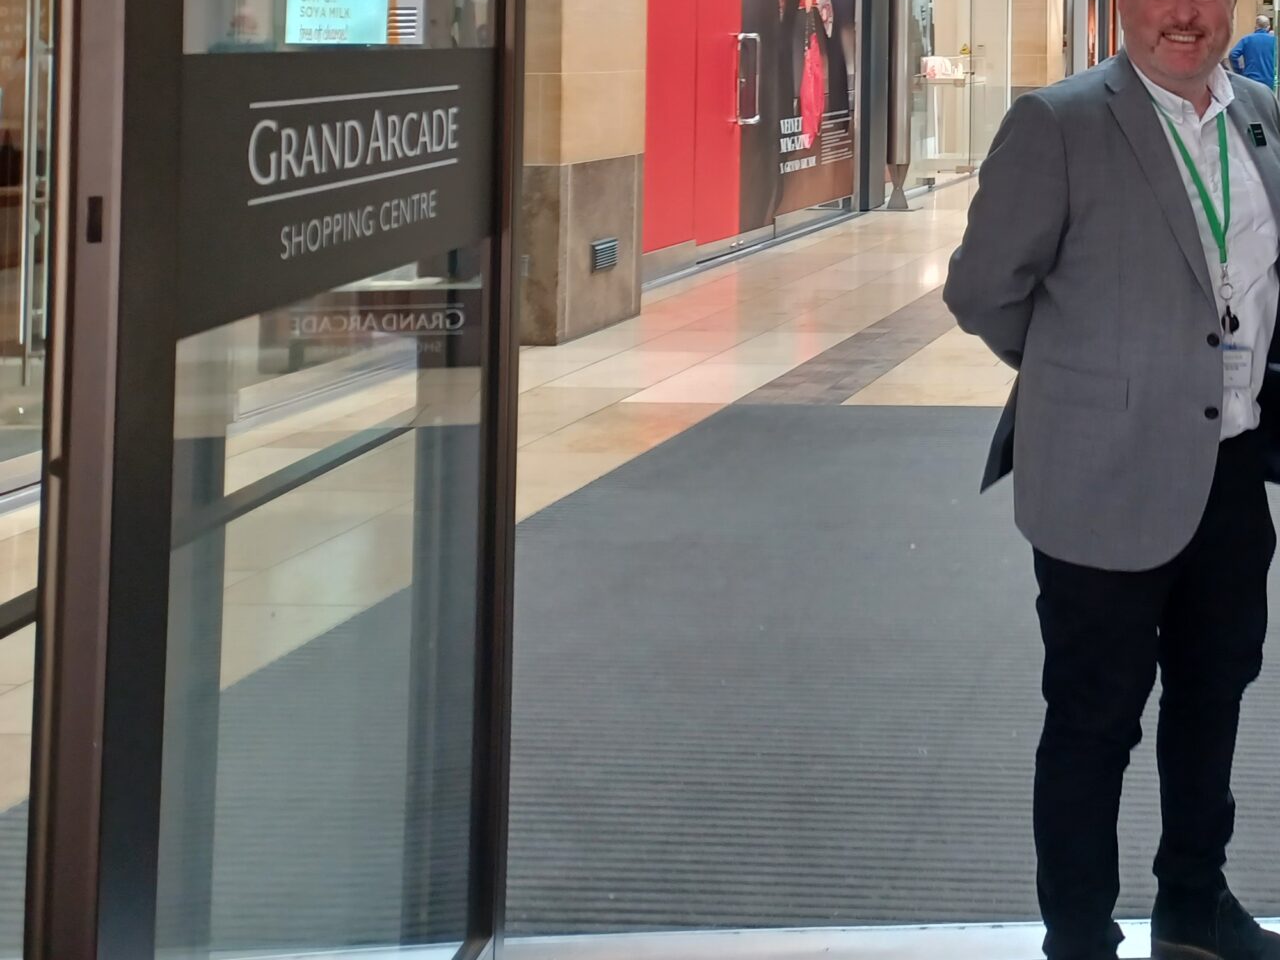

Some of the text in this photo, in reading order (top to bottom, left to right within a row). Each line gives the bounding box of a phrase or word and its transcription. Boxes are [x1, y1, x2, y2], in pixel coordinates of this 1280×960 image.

[299, 6, 351, 19] SOYA MILK
[247, 107, 460, 186] GRAND ARCADE
[280, 190, 437, 260] SHOPPING CENTRE
